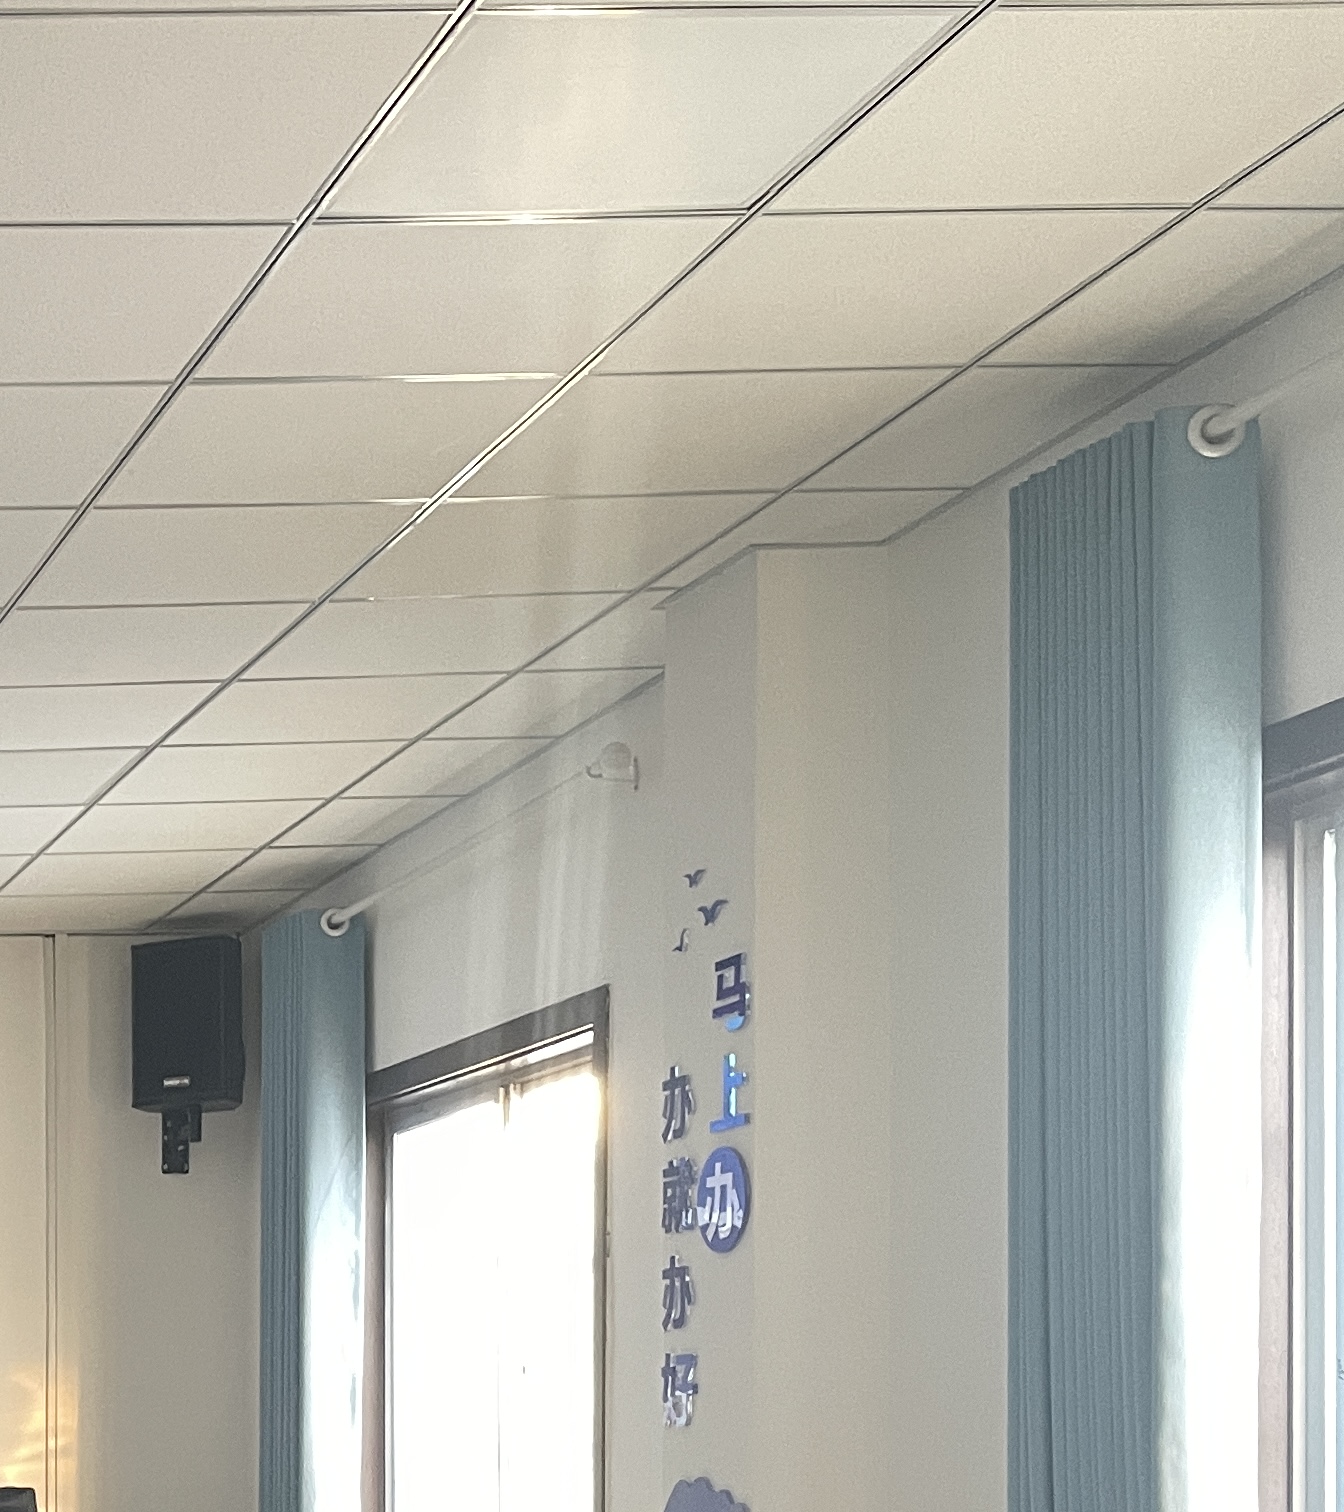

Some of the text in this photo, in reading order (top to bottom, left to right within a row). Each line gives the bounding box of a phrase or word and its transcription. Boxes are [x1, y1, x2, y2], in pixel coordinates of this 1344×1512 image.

[660, 1065, 699, 1428] 办就办好
[701, 952, 752, 1241] 马上办
